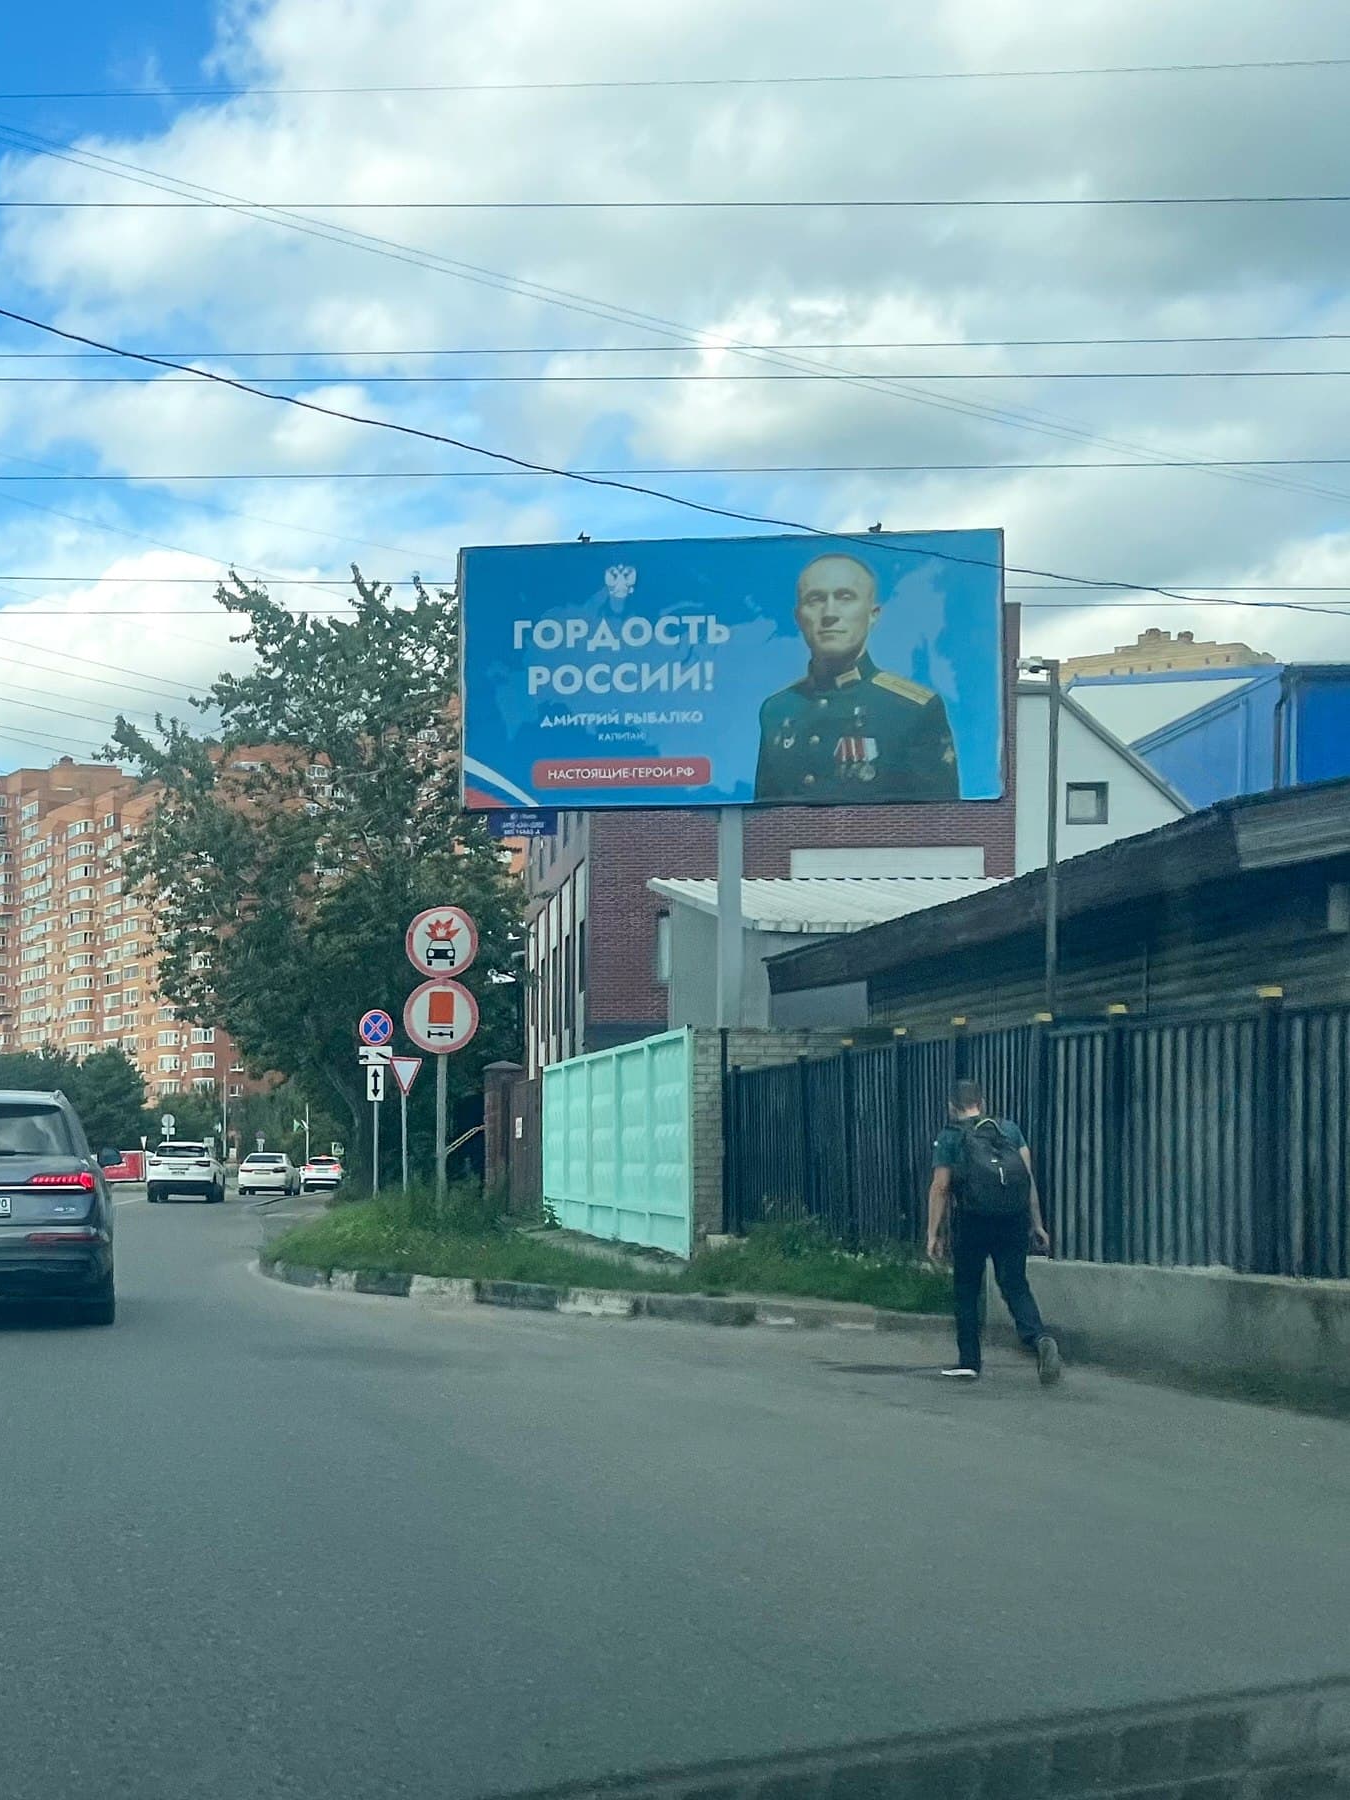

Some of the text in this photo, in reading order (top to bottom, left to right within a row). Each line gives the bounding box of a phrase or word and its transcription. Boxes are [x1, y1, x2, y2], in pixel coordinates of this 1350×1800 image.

[513, 615, 731, 651] ГОРДОСТЬ
[527, 660, 714, 695] РОССИИ!
[540, 709, 703, 728] ДМИТРИЙ РЫБАЛКО
[547, 766, 695, 781] НАСТОЯЩИЕ-ГЕРОИ.РФ
